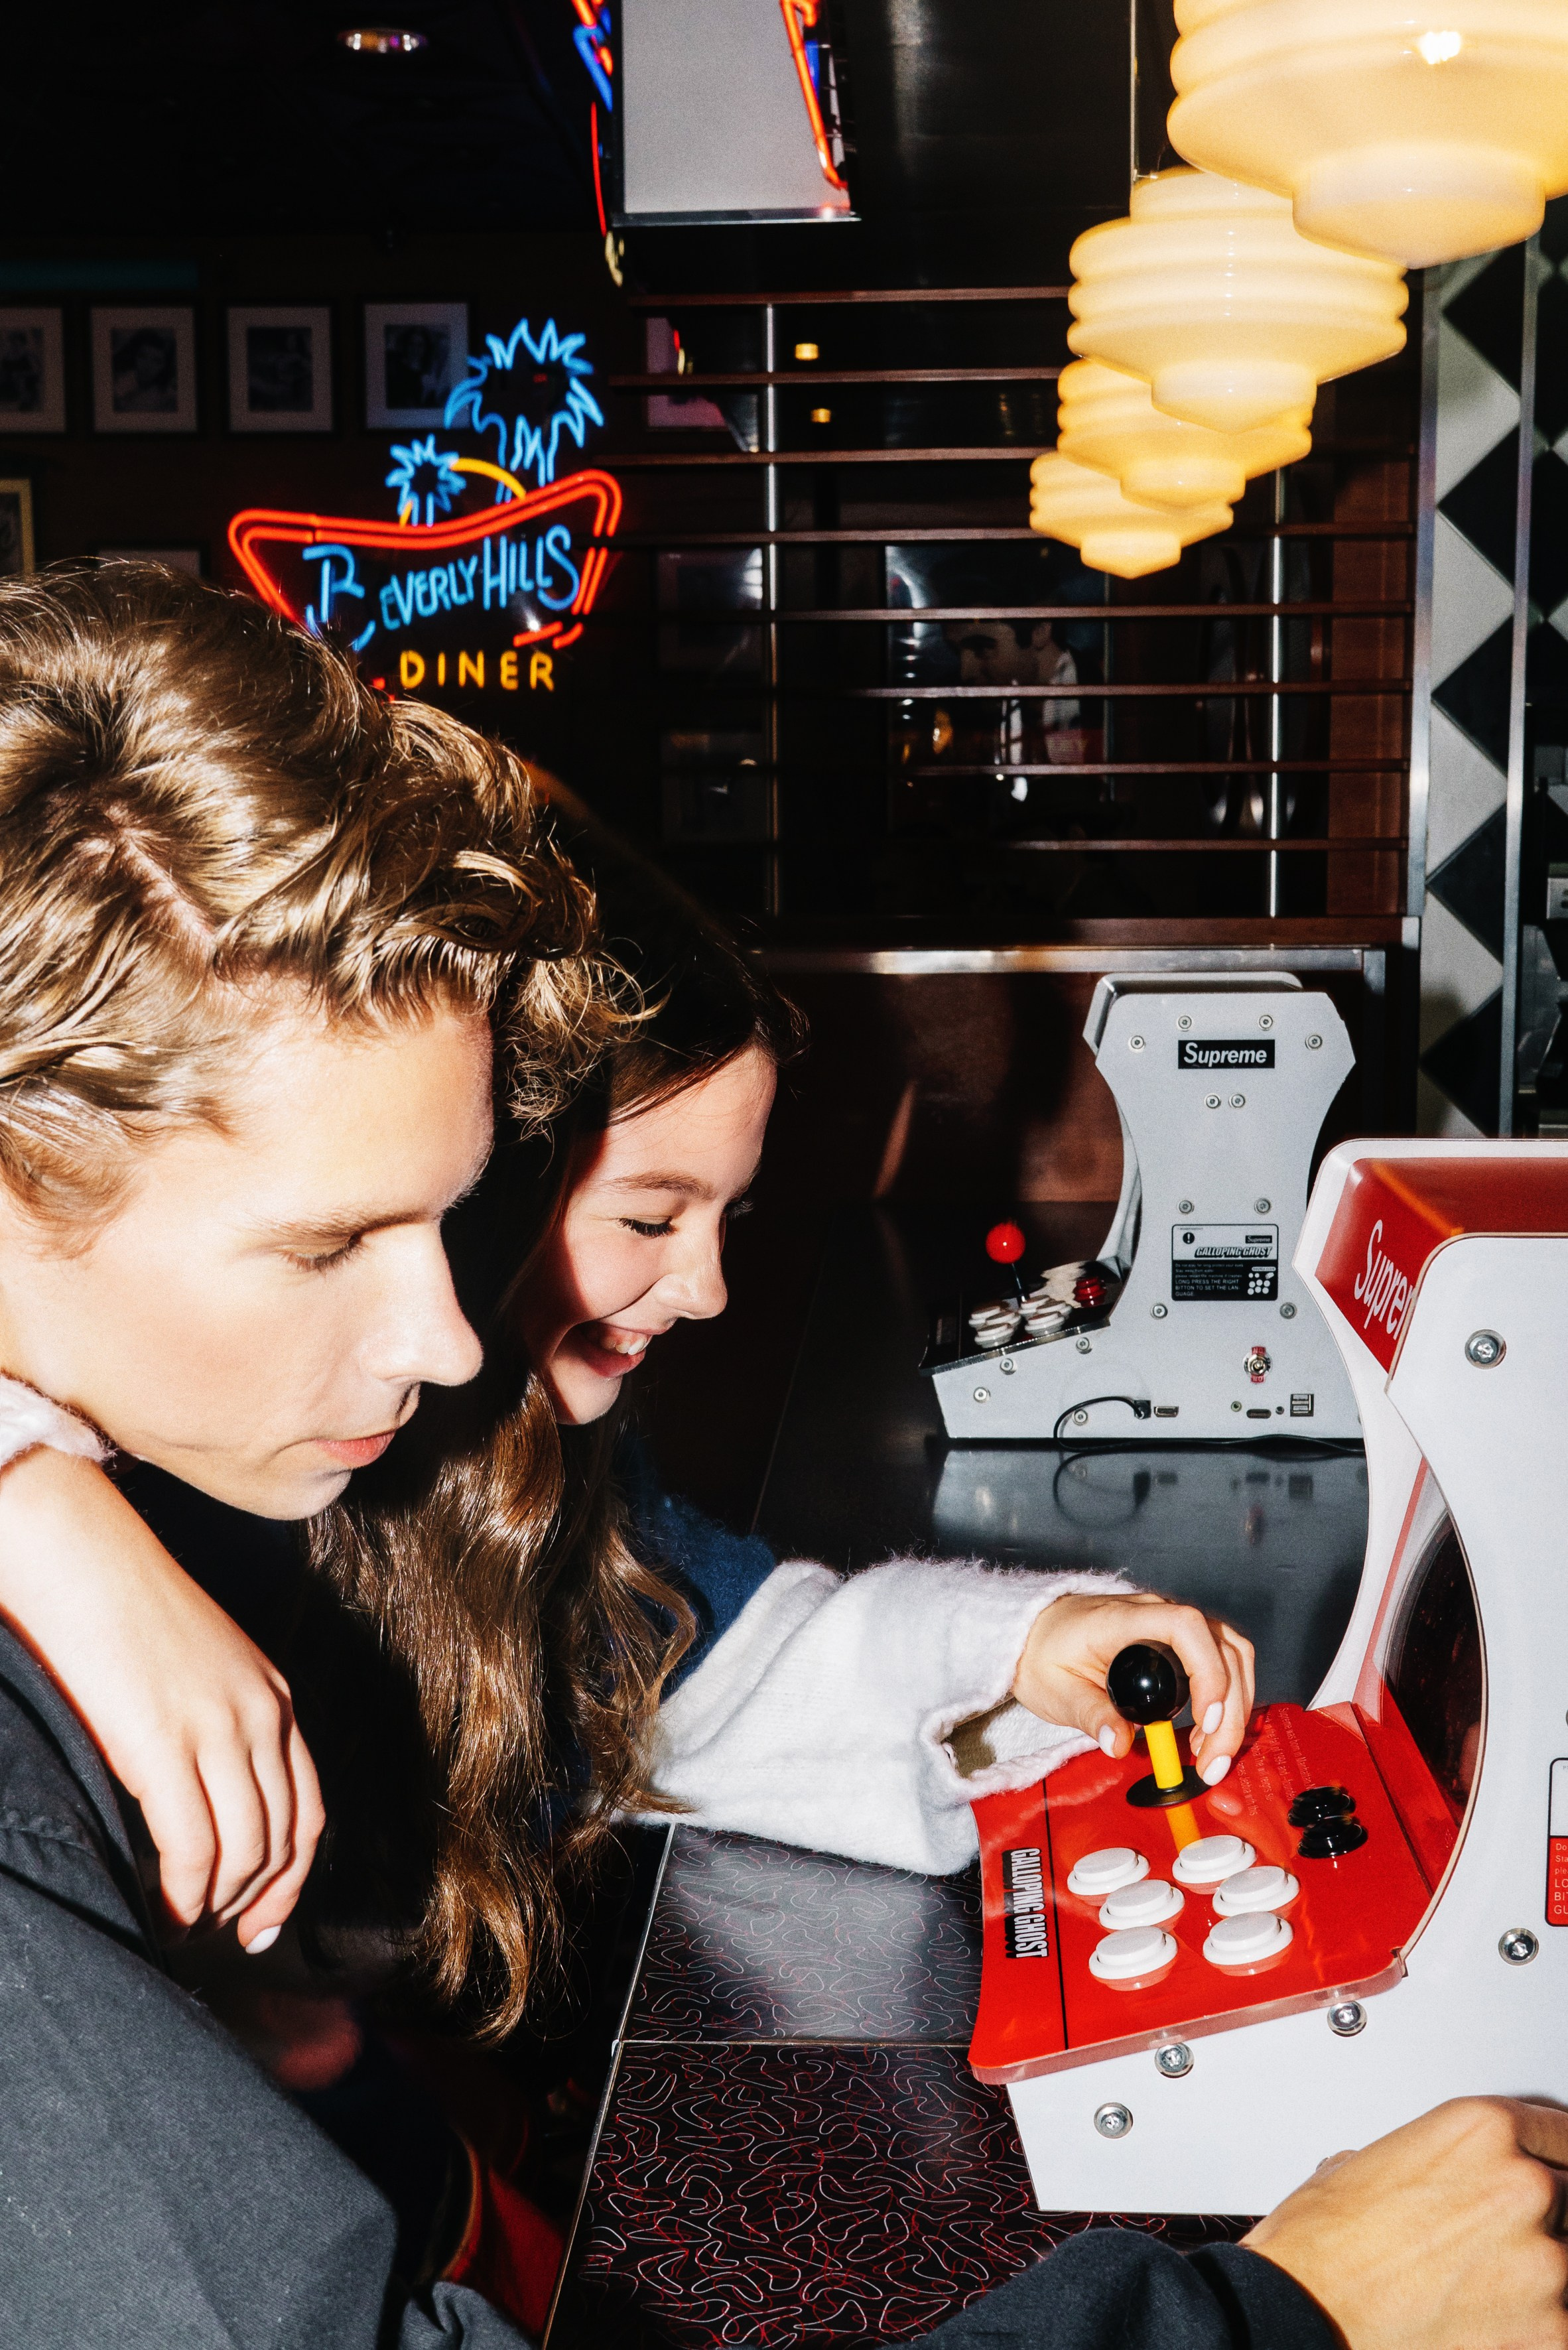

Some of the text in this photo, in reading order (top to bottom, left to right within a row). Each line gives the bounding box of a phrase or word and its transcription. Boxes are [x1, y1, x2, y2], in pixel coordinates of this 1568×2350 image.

[483, 525, 581, 610] HILLS
[400, 649, 555, 692] DINER
[1183, 1042, 1268, 1067] Supreme
[1195, 1247, 1272, 1257] GALLOPING GHOST
[1279, 1707, 1292, 1730] Supreme
[1285, 1729, 1295, 1739] was
[1274, 1752, 1287, 1765] 1994
[1277, 1765, 1289, 1776] and
[1009, 1848, 1049, 1958] GALLOPING GHOST
